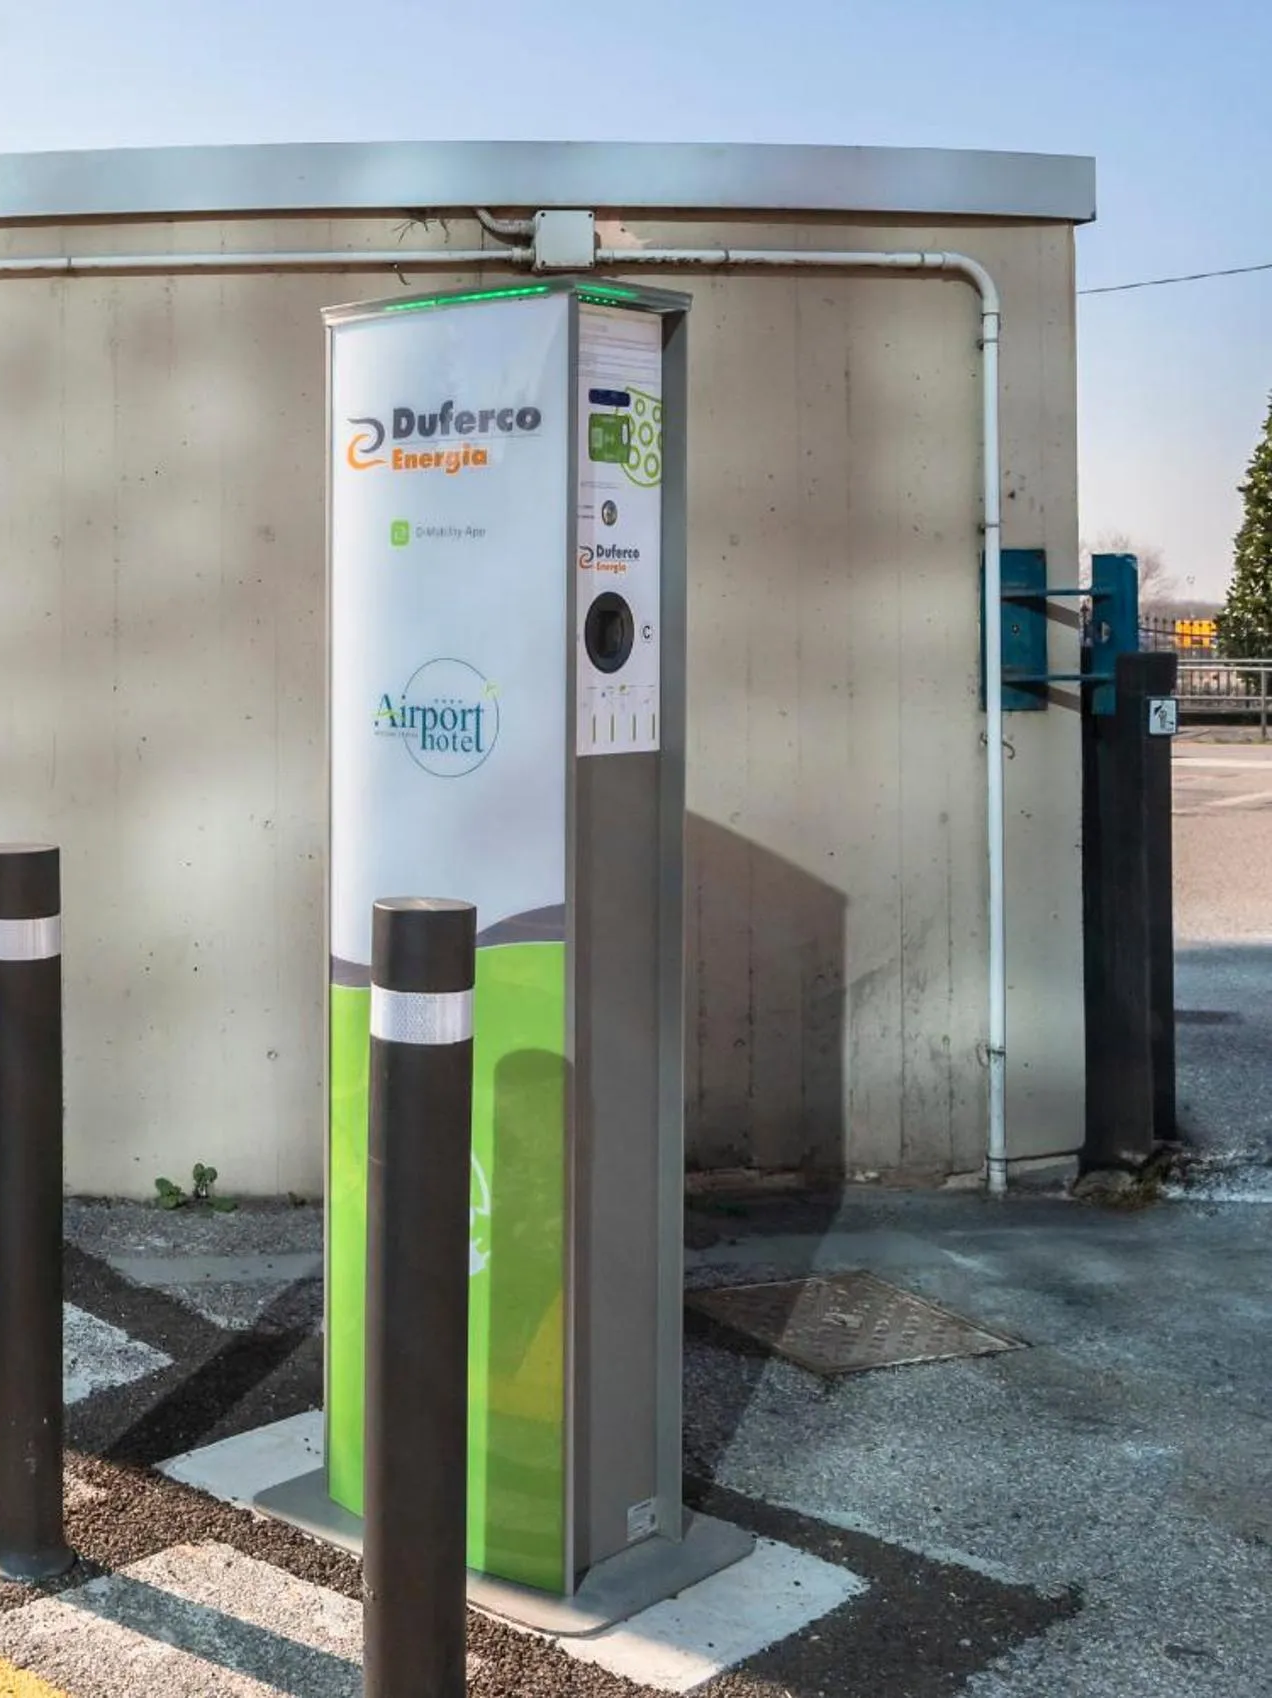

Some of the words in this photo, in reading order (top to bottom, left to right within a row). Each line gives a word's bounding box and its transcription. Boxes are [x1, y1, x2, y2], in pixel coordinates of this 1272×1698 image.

[392, 400, 542, 440] Duferco
[391, 446, 488, 475] Energia
[596, 544, 640, 559] Duferco
[596, 561, 626, 574] Energia
[373, 693, 485, 742] Airport
[420, 730, 485, 753] hotel
